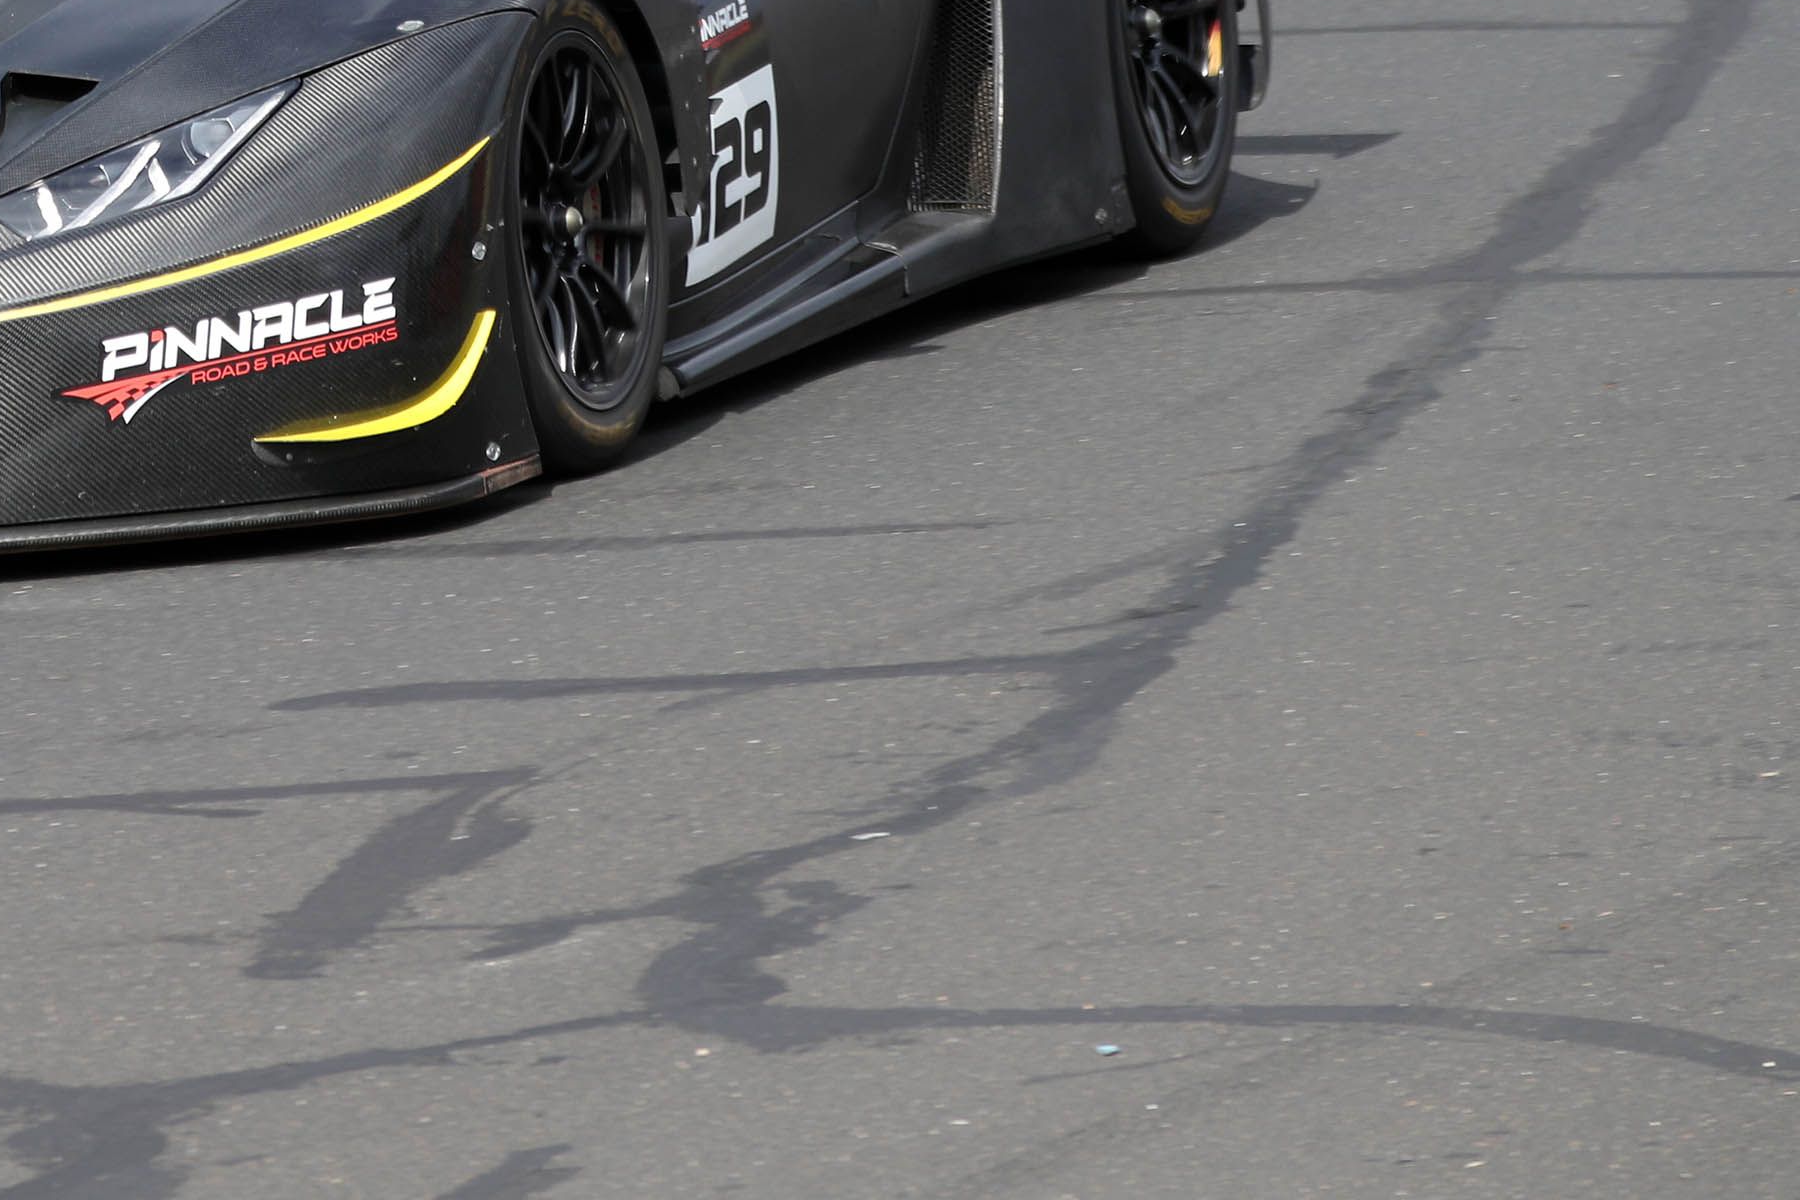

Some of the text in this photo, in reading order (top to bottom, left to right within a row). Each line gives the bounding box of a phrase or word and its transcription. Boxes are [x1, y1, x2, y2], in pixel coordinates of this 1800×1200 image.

[191, 328, 397, 385] ROAD & RACE WORKS
